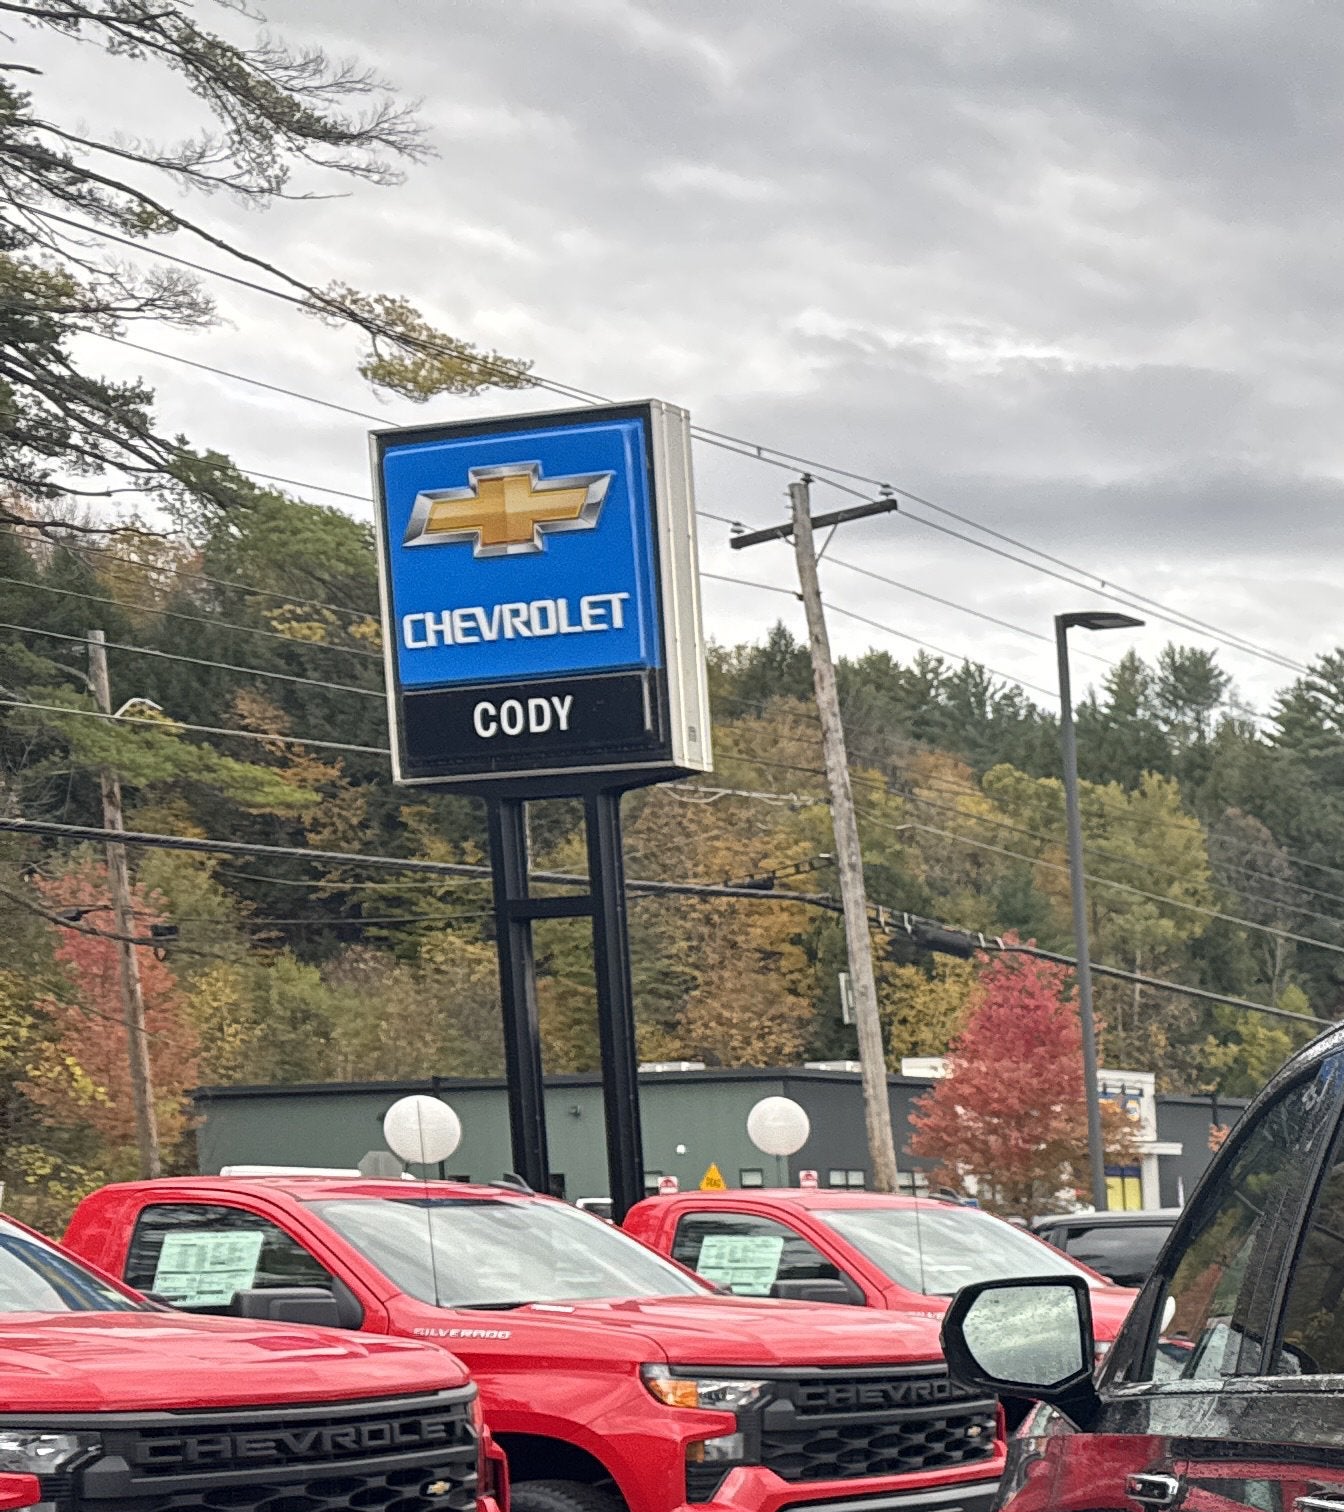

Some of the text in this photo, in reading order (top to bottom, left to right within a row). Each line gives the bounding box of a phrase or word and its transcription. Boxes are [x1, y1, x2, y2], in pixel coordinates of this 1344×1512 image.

[403, 592, 630, 650] CHEVROLET
[473, 695, 574, 738] CODY
[413, 1327, 511, 1339] SILVERADO
